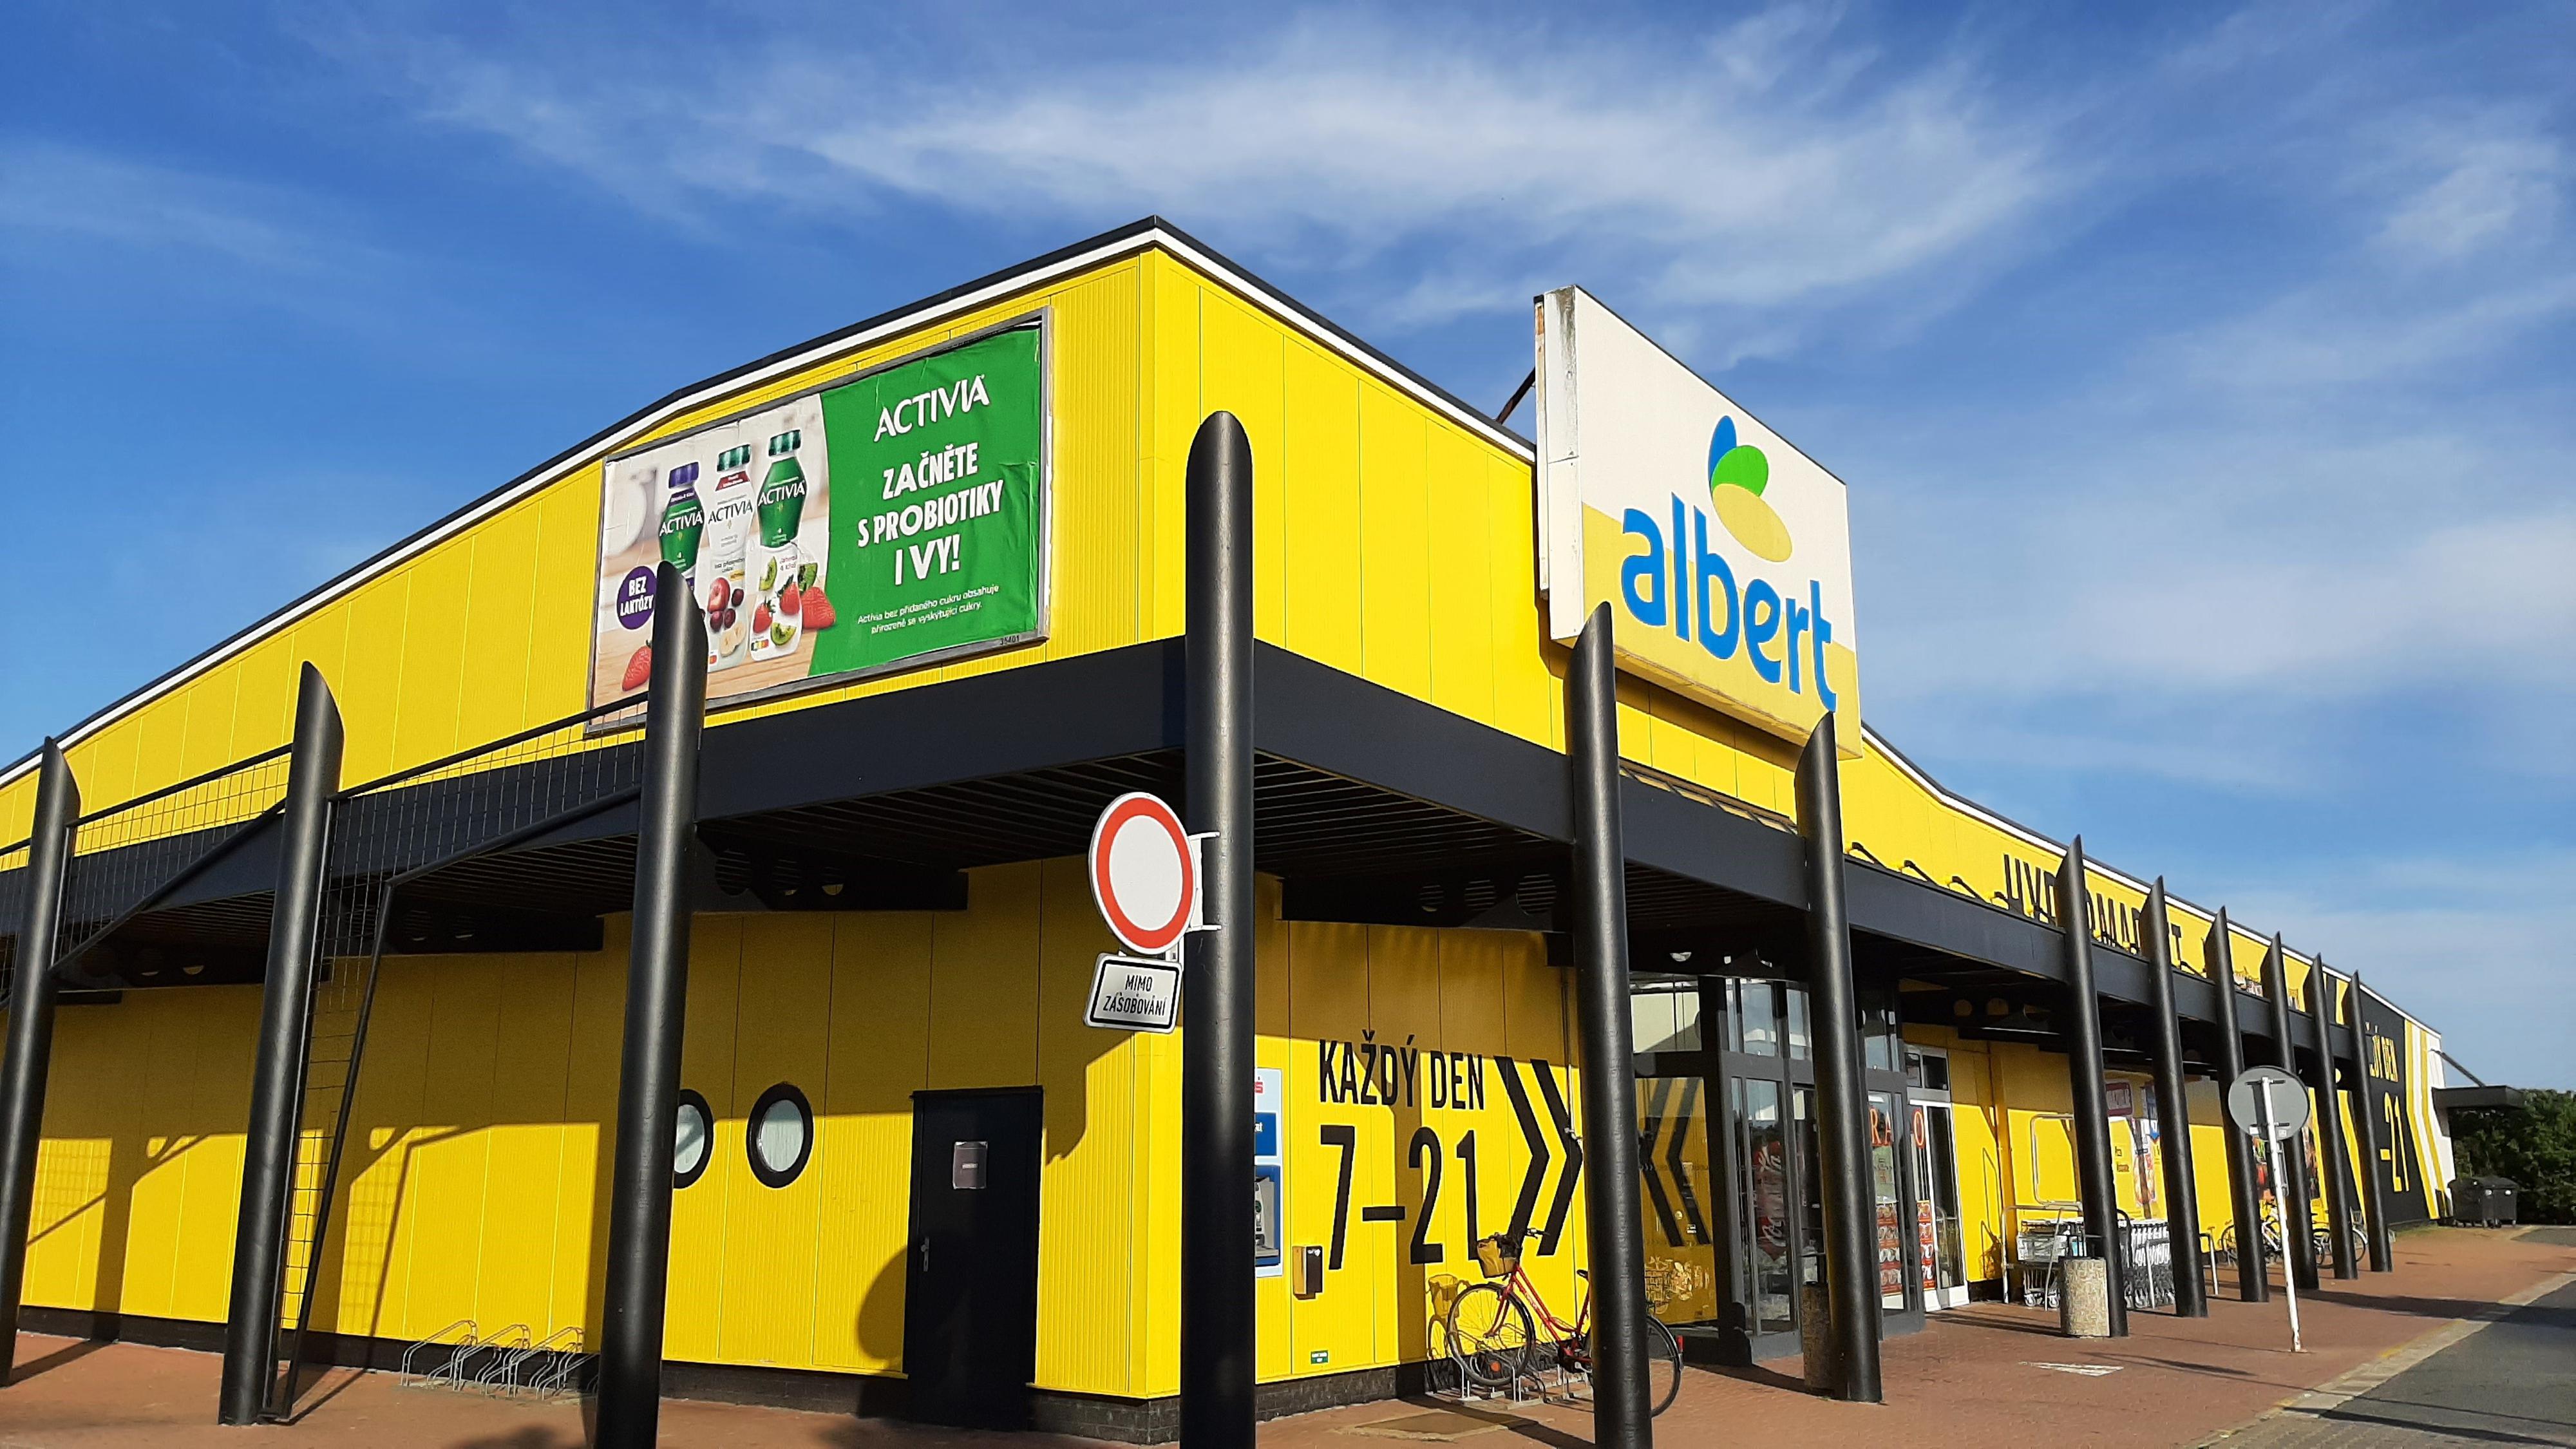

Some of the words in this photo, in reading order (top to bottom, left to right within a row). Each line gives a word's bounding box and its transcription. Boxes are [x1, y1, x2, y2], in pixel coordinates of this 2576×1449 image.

[873, 374, 990, 442] ACTIVIA
[882, 442, 978, 500] ZAČNĚTE
[757, 480, 806, 507] ACTIVIA
[659, 511, 704, 537] ACTIVIA
[708, 499, 753, 525] ACTIVIA
[857, 518, 869, 547] S
[873, 479, 1003, 544] PROBIOTIKY
[895, 549, 903, 585] I
[909, 533, 960, 580] VY!
[628, 576, 647, 596] BEZ
[1620, 491, 1837, 712] albert
[620, 594, 654, 616] LAKTÓZY
[857, 614, 883, 624] Activia
[884, 610, 898, 619] bez
[899, 600, 938, 616] přidaného
[939, 594, 961, 605] cukru
[963, 584, 999, 600] obsahuje
[1124, 974, 1153, 992] MIMO
[1103, 992, 1168, 1016] ZÁSOBOVÁNÍ
[1320, 1029, 1417, 1108] KAŽDÝ
[1430, 1050, 1484, 1110] DEN
